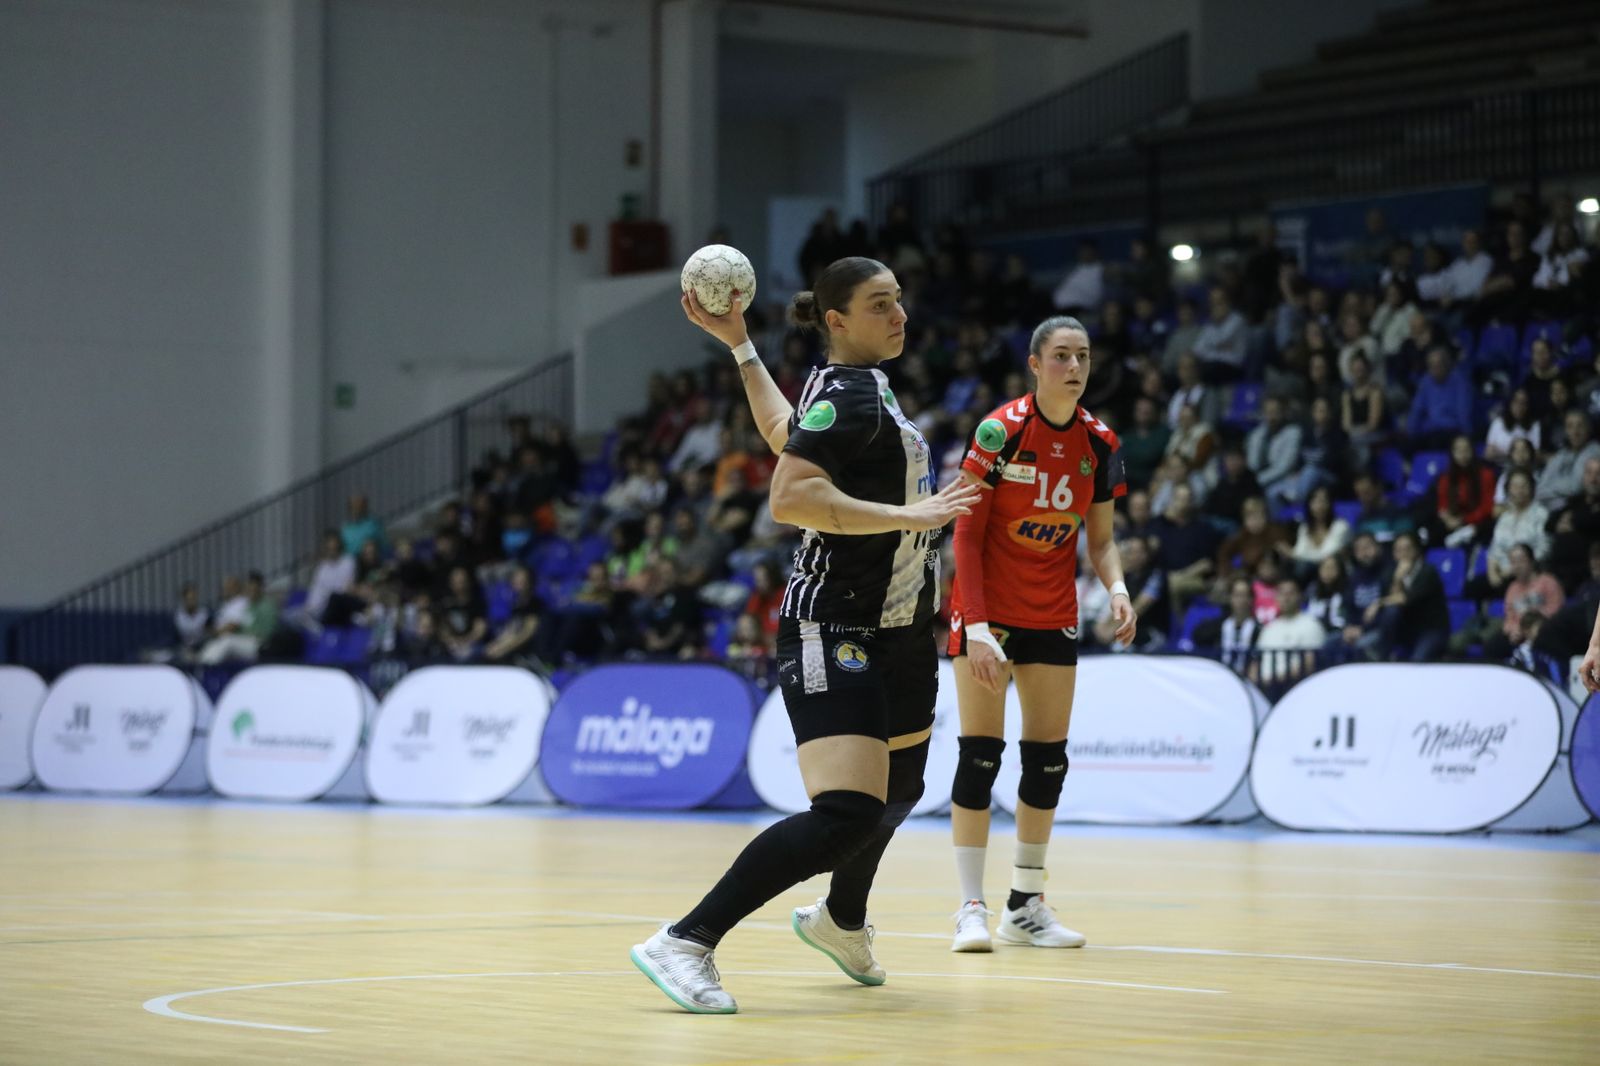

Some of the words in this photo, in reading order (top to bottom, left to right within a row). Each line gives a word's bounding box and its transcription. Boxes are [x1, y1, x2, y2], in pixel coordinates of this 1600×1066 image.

[1033, 472, 1074, 510] 16
[575, 696, 715, 768] málaga
[1411, 719, 1508, 761] Málaga
